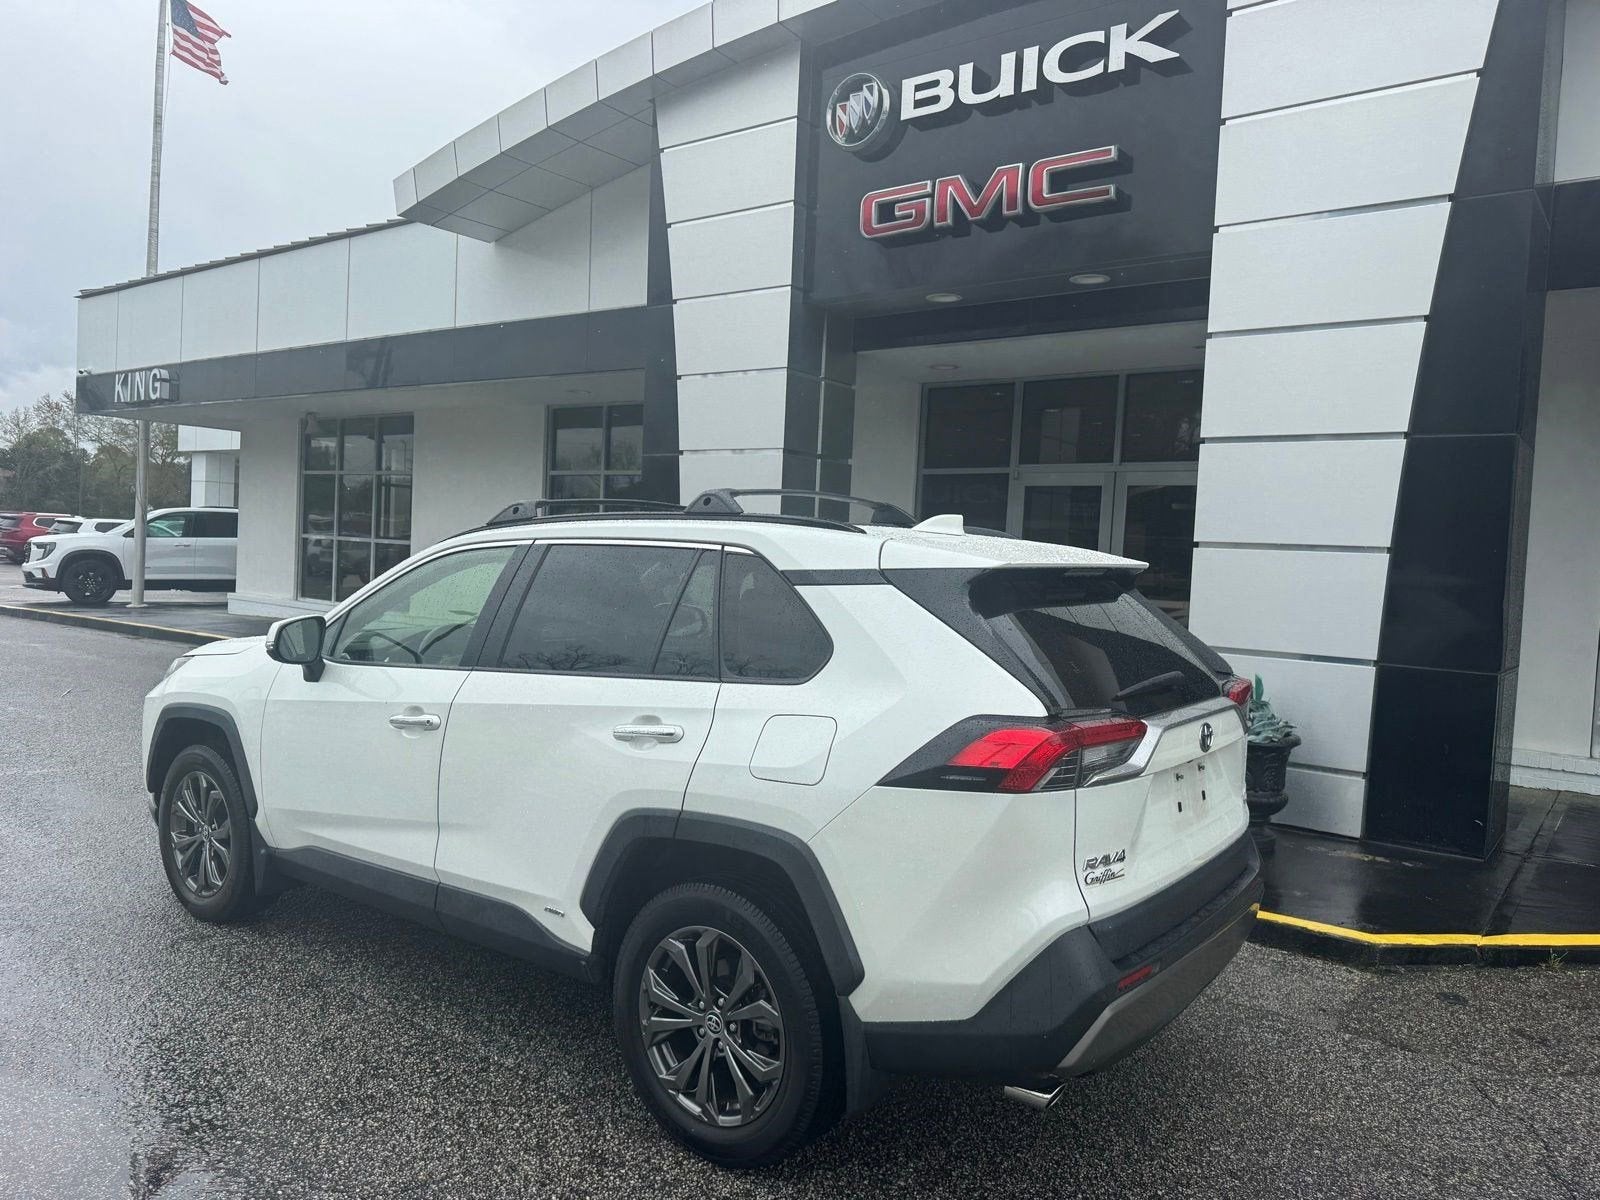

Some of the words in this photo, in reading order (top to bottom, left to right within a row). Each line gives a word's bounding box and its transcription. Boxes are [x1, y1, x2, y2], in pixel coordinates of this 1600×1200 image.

[900, 9, 1180, 121] BUICK
[859, 144, 1119, 239] GMC
[114, 368, 162, 402] KING
[1083, 848, 1126, 871] RAV4
[1084, 868, 1125, 885] Griffin
